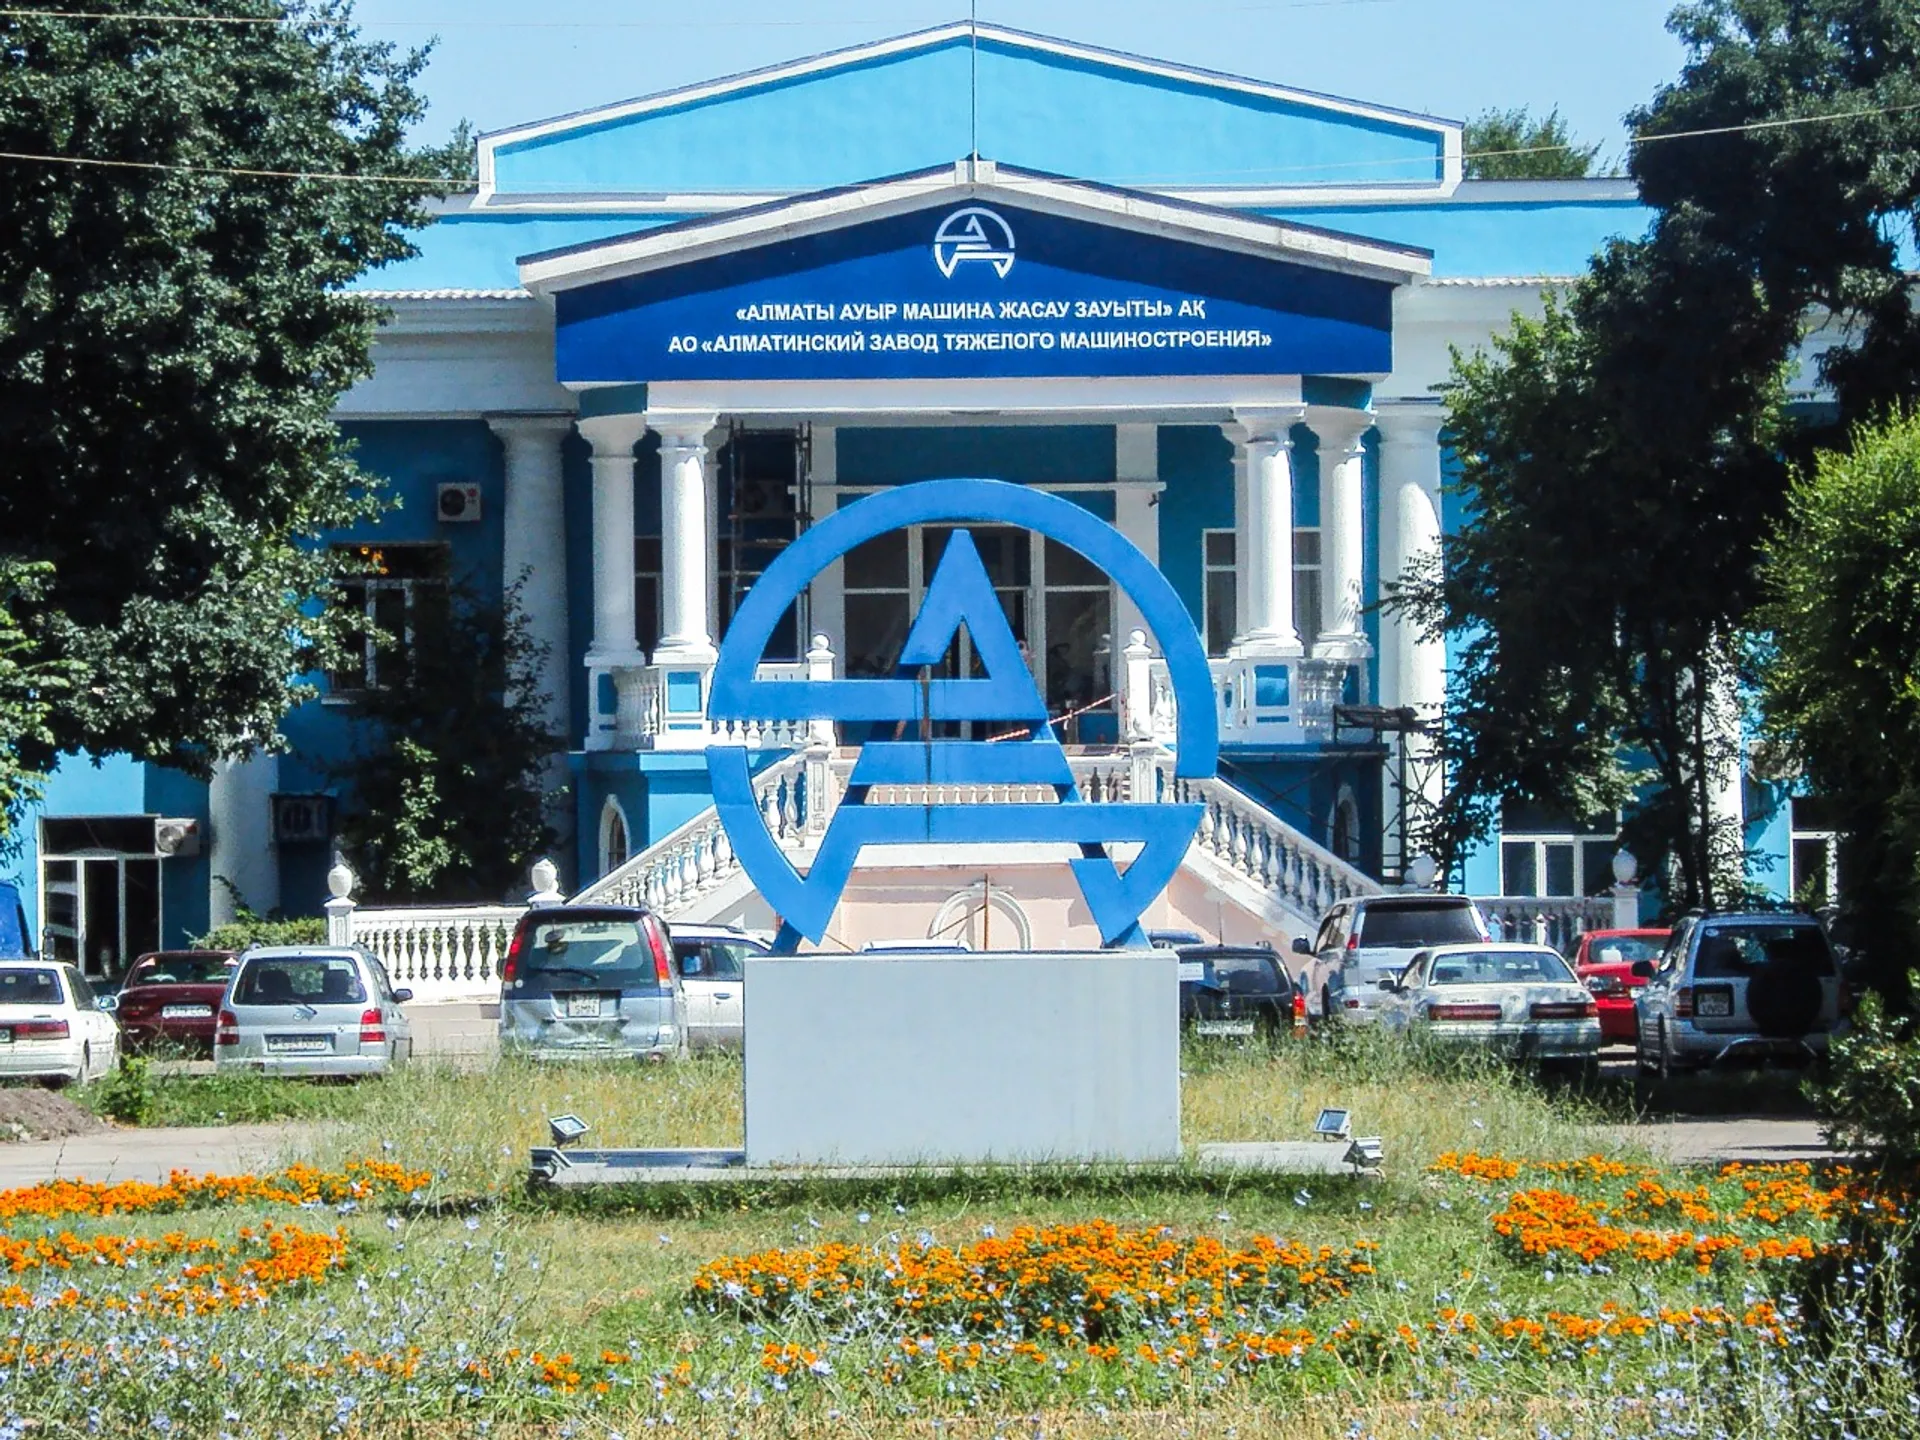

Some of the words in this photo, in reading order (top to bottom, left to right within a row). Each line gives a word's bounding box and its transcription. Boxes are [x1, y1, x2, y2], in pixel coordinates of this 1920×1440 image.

[736, 303, 835, 321] «АЛМАТЫ
[839, 303, 898, 321] АУЫР
[903, 302, 995, 320] МАШИНА
[998, 301, 1071, 319] ЖАСАУ
[1074, 300, 1173, 318] ЗАУЫТЫ»
[1177, 300, 1206, 320] АҚ
[668, 335, 698, 353] АО
[701, 331, 865, 353] «АЛМАТИНСКИЙ
[869, 333, 939, 353] ЗАВОД
[943, 332, 1055, 351] ТЯЖЕЛОГО
[1060, 330, 1272, 349] МАШИНОСТРОЕНИЯ»
